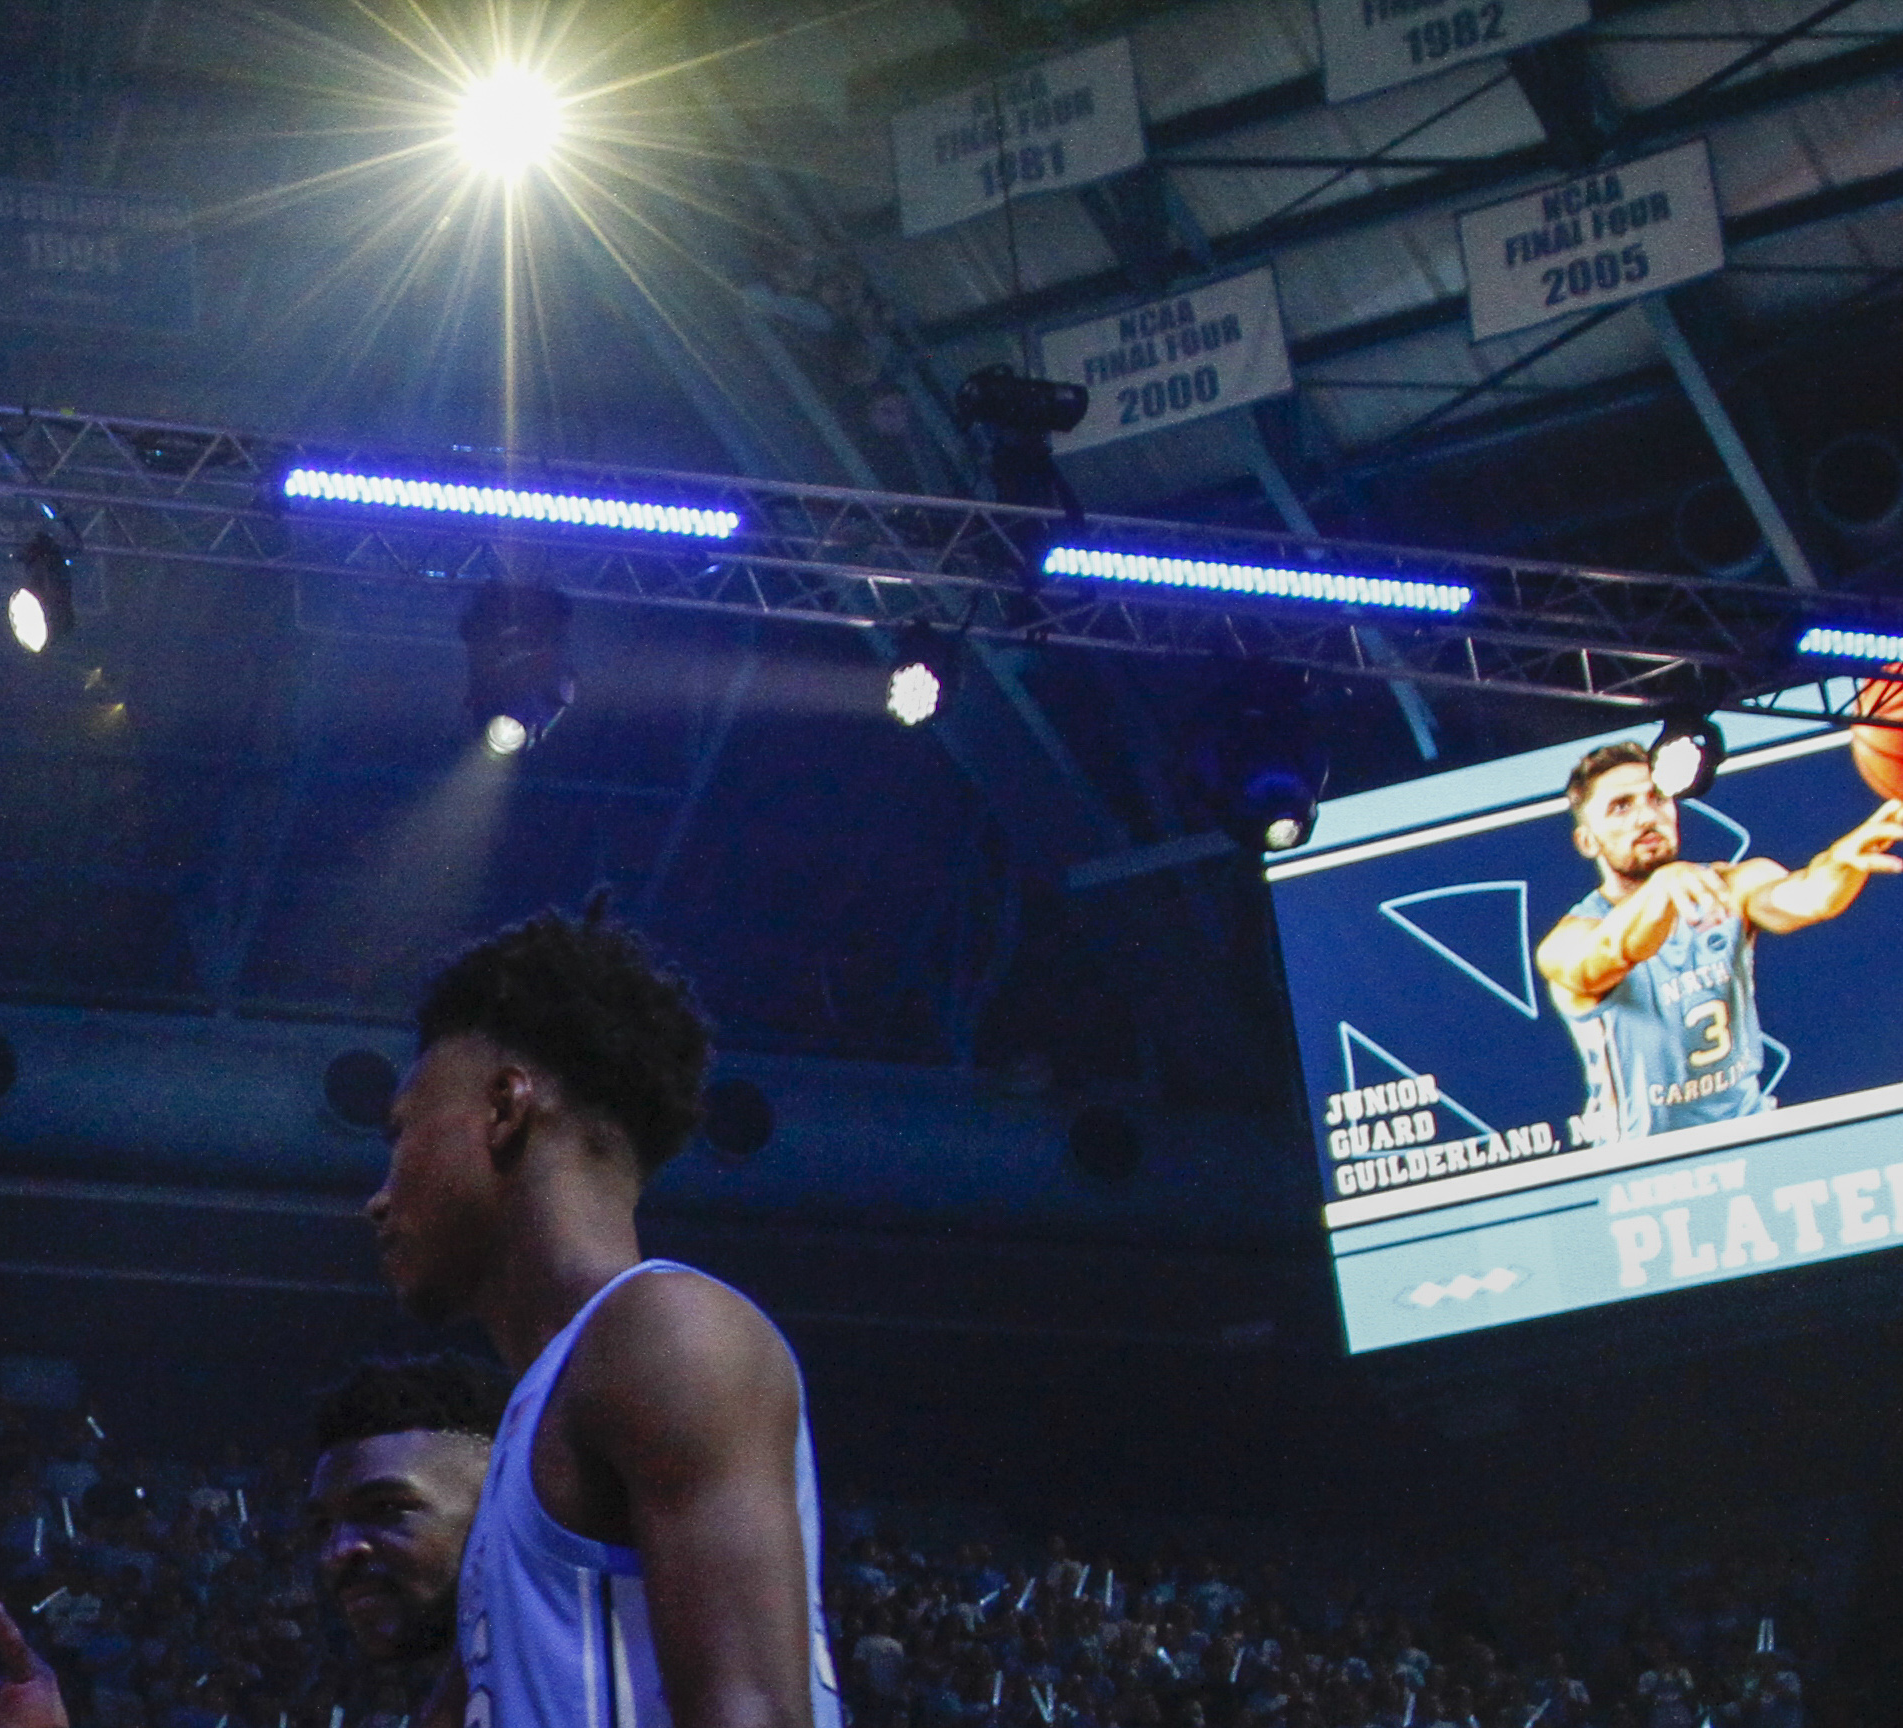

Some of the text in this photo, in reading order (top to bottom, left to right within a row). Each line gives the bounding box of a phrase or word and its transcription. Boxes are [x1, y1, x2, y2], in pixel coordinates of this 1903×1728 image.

[1405, 1, 1507, 64] 1982
[1541, 172, 1624, 221] NCAA
[1505, 190, 1672, 267] FINAL FOUR
[1540, 242, 1649, 306] 2005
[1082, 313, 1242, 389] FINAL FOUR
[1118, 298, 1196, 343] NCAA
[1116, 363, 1221, 426] 2000
[1683, 997, 1733, 1068] 3
[1324, 1073, 1440, 1126] JUNIOR
[1329, 1110, 1436, 1160] GUARD
[1334, 1121, 1561, 1196] GUILDERLAND,
